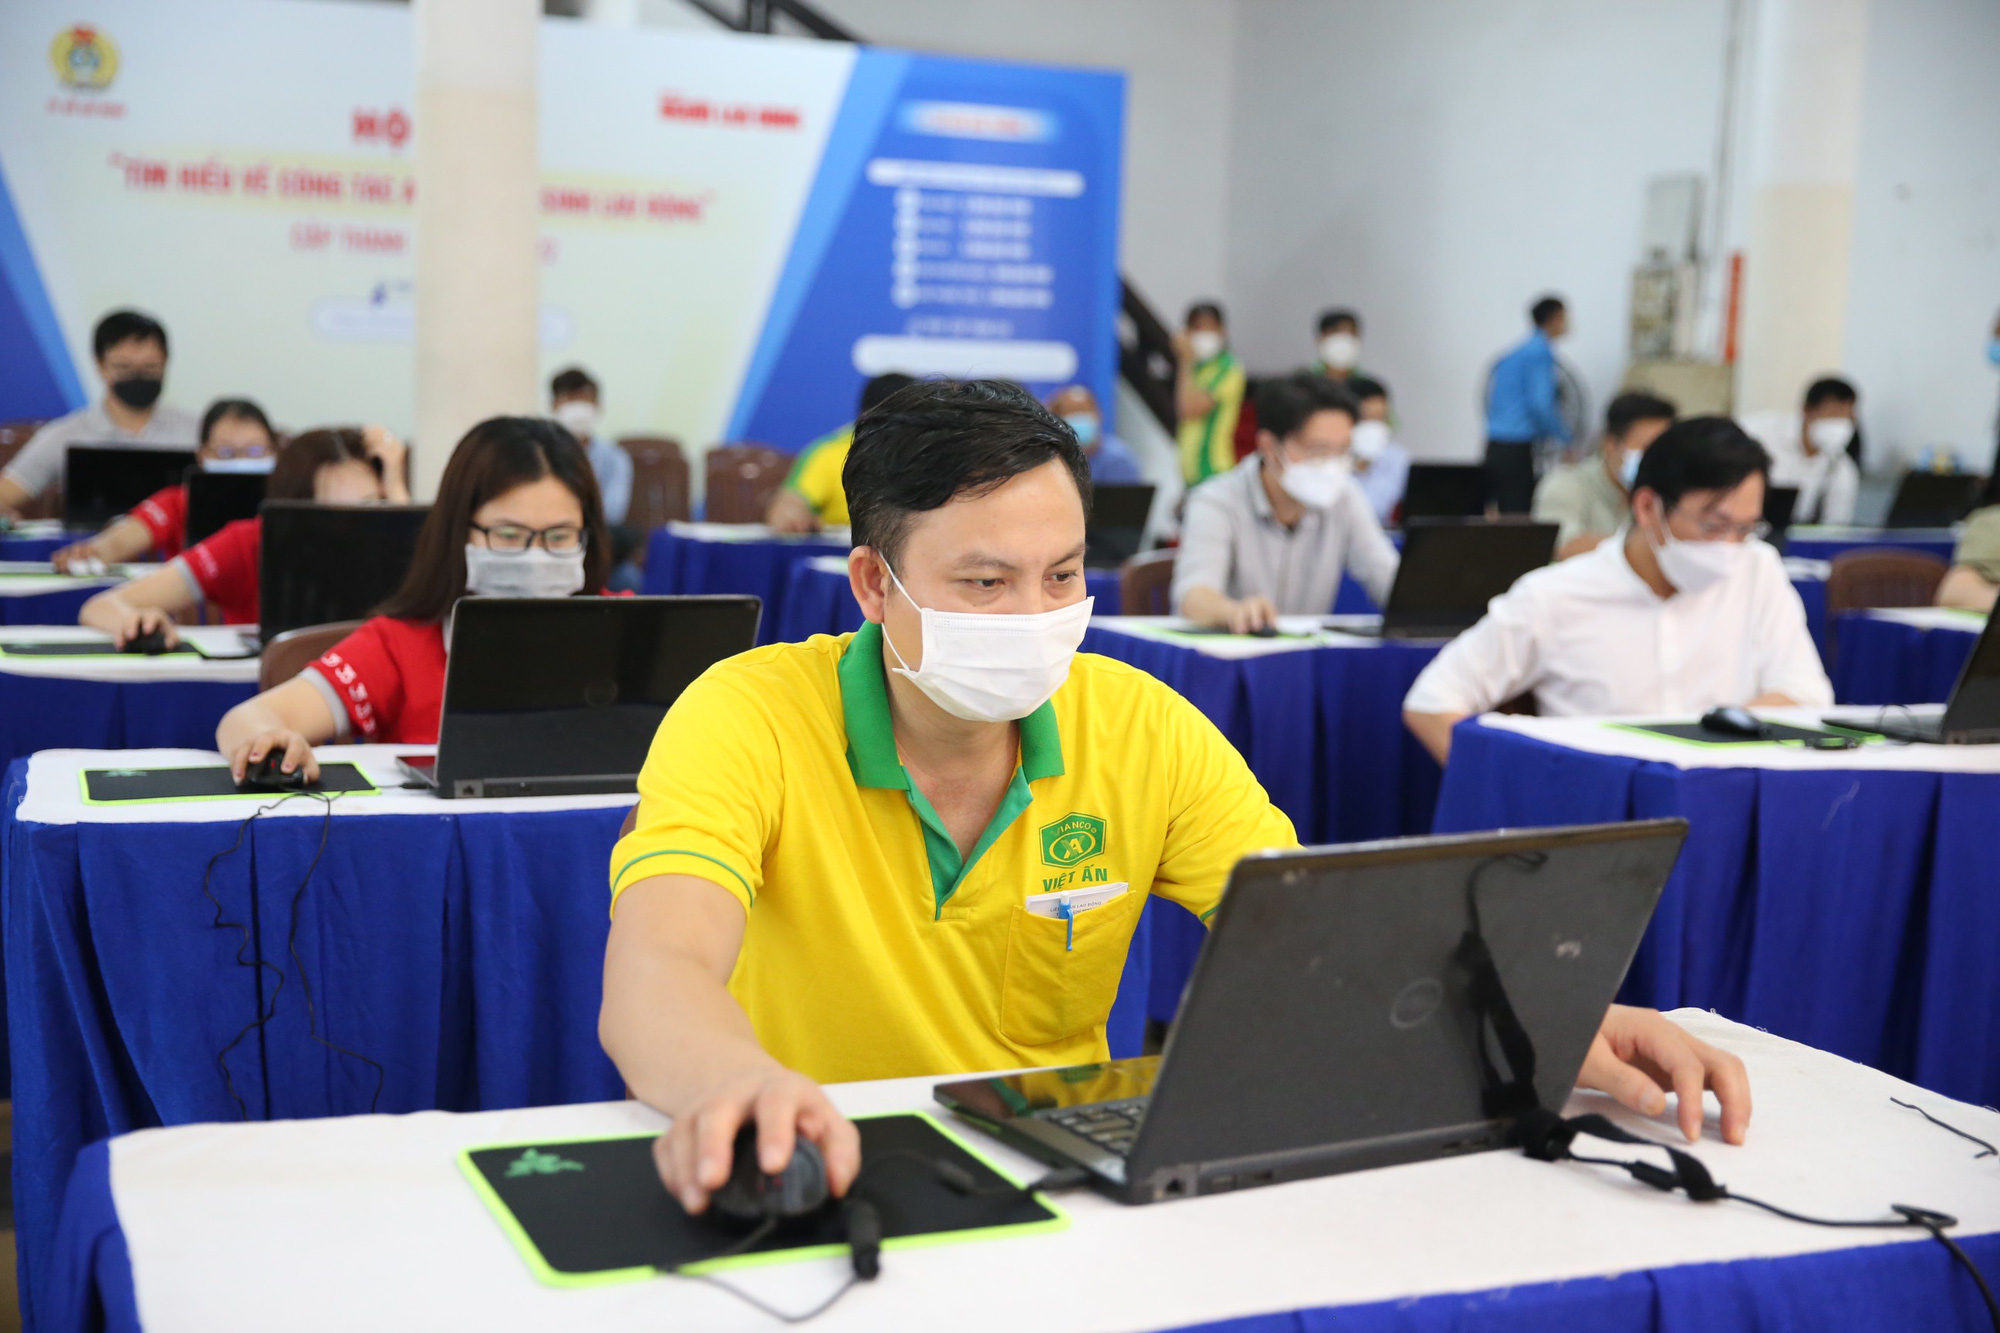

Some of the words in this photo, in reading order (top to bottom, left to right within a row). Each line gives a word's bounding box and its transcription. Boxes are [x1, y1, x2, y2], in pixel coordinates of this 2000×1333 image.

[352, 107, 411, 148] HỘ
[1042, 871, 1076, 892] VIỆT
[1081, 864, 1108, 883] ẤN
